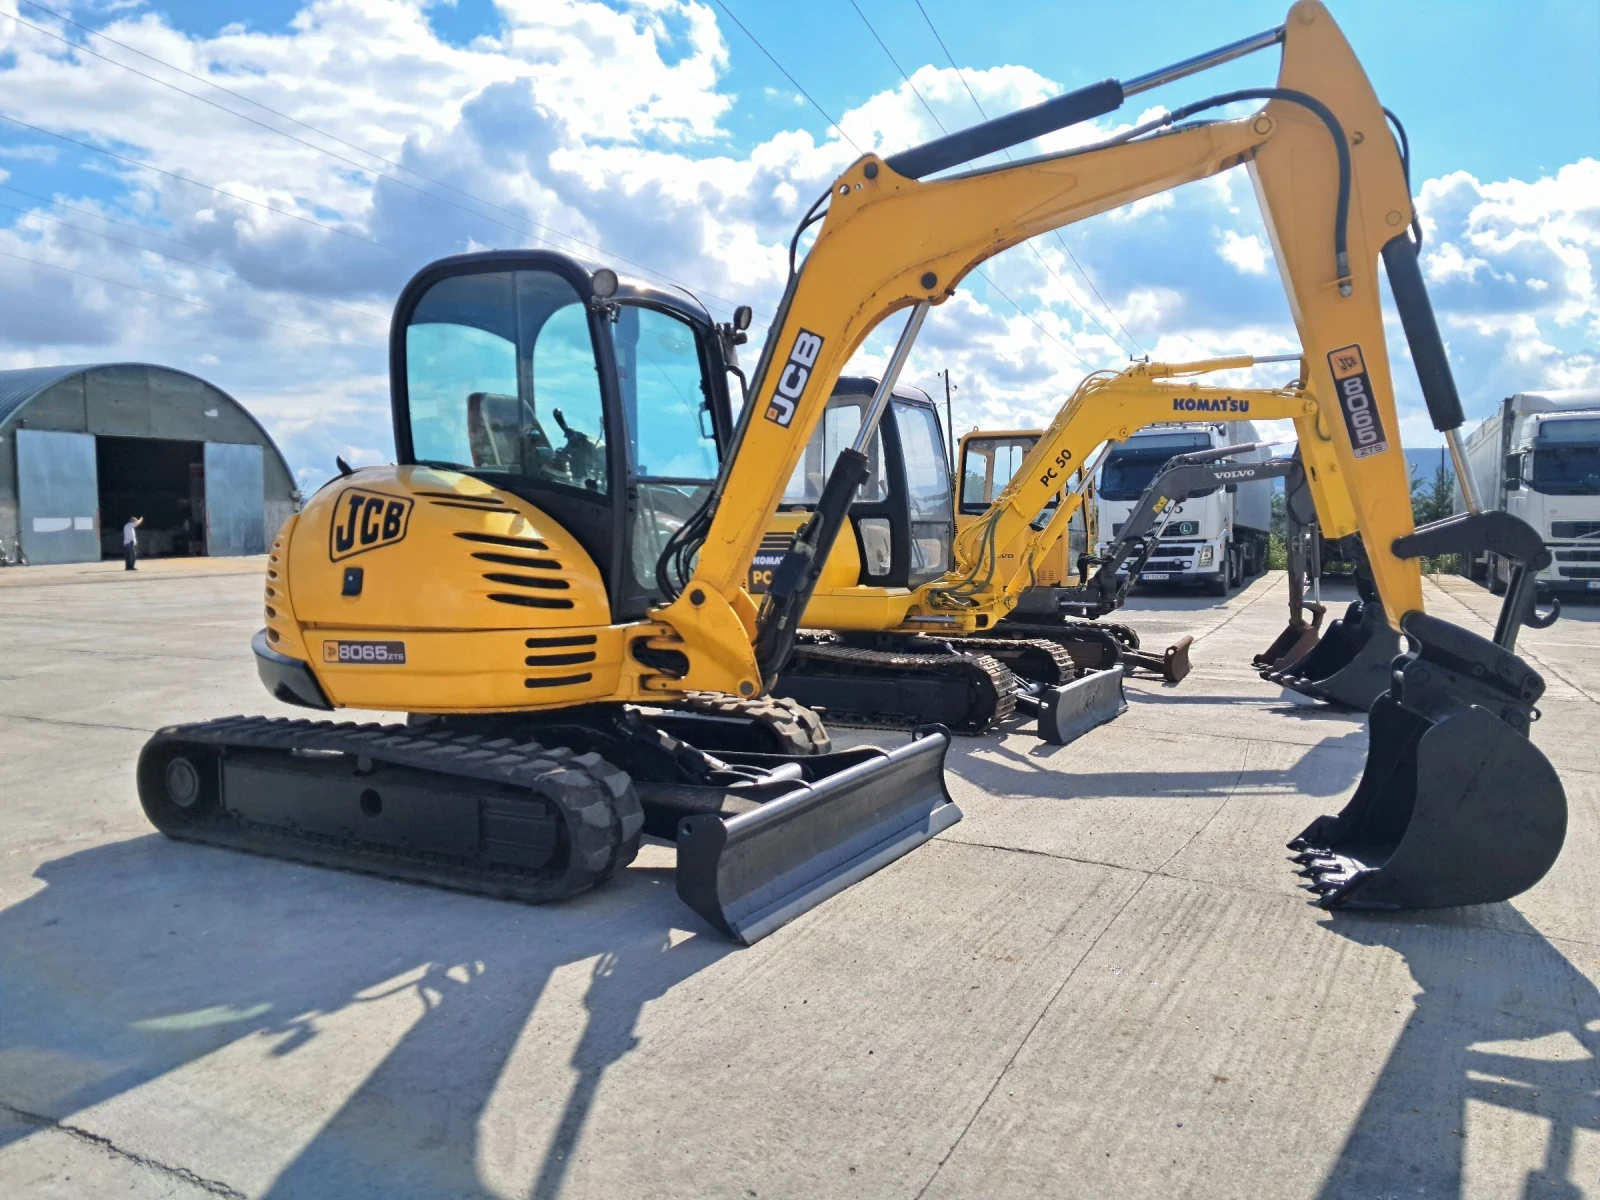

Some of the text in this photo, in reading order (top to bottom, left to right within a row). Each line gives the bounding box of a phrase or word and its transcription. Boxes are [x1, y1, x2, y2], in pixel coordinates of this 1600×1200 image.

[772, 331, 821, 425] JCB
[1173, 396, 1250, 412] KOMATSU
[1343, 377, 1378, 445] 8065
[1360, 444, 1383, 456] ZTS
[1040, 449, 1072, 487] PC 50
[1213, 469, 1255, 479] VOLVO
[336, 494, 405, 552] JCB
[339, 644, 388, 660] 8065
